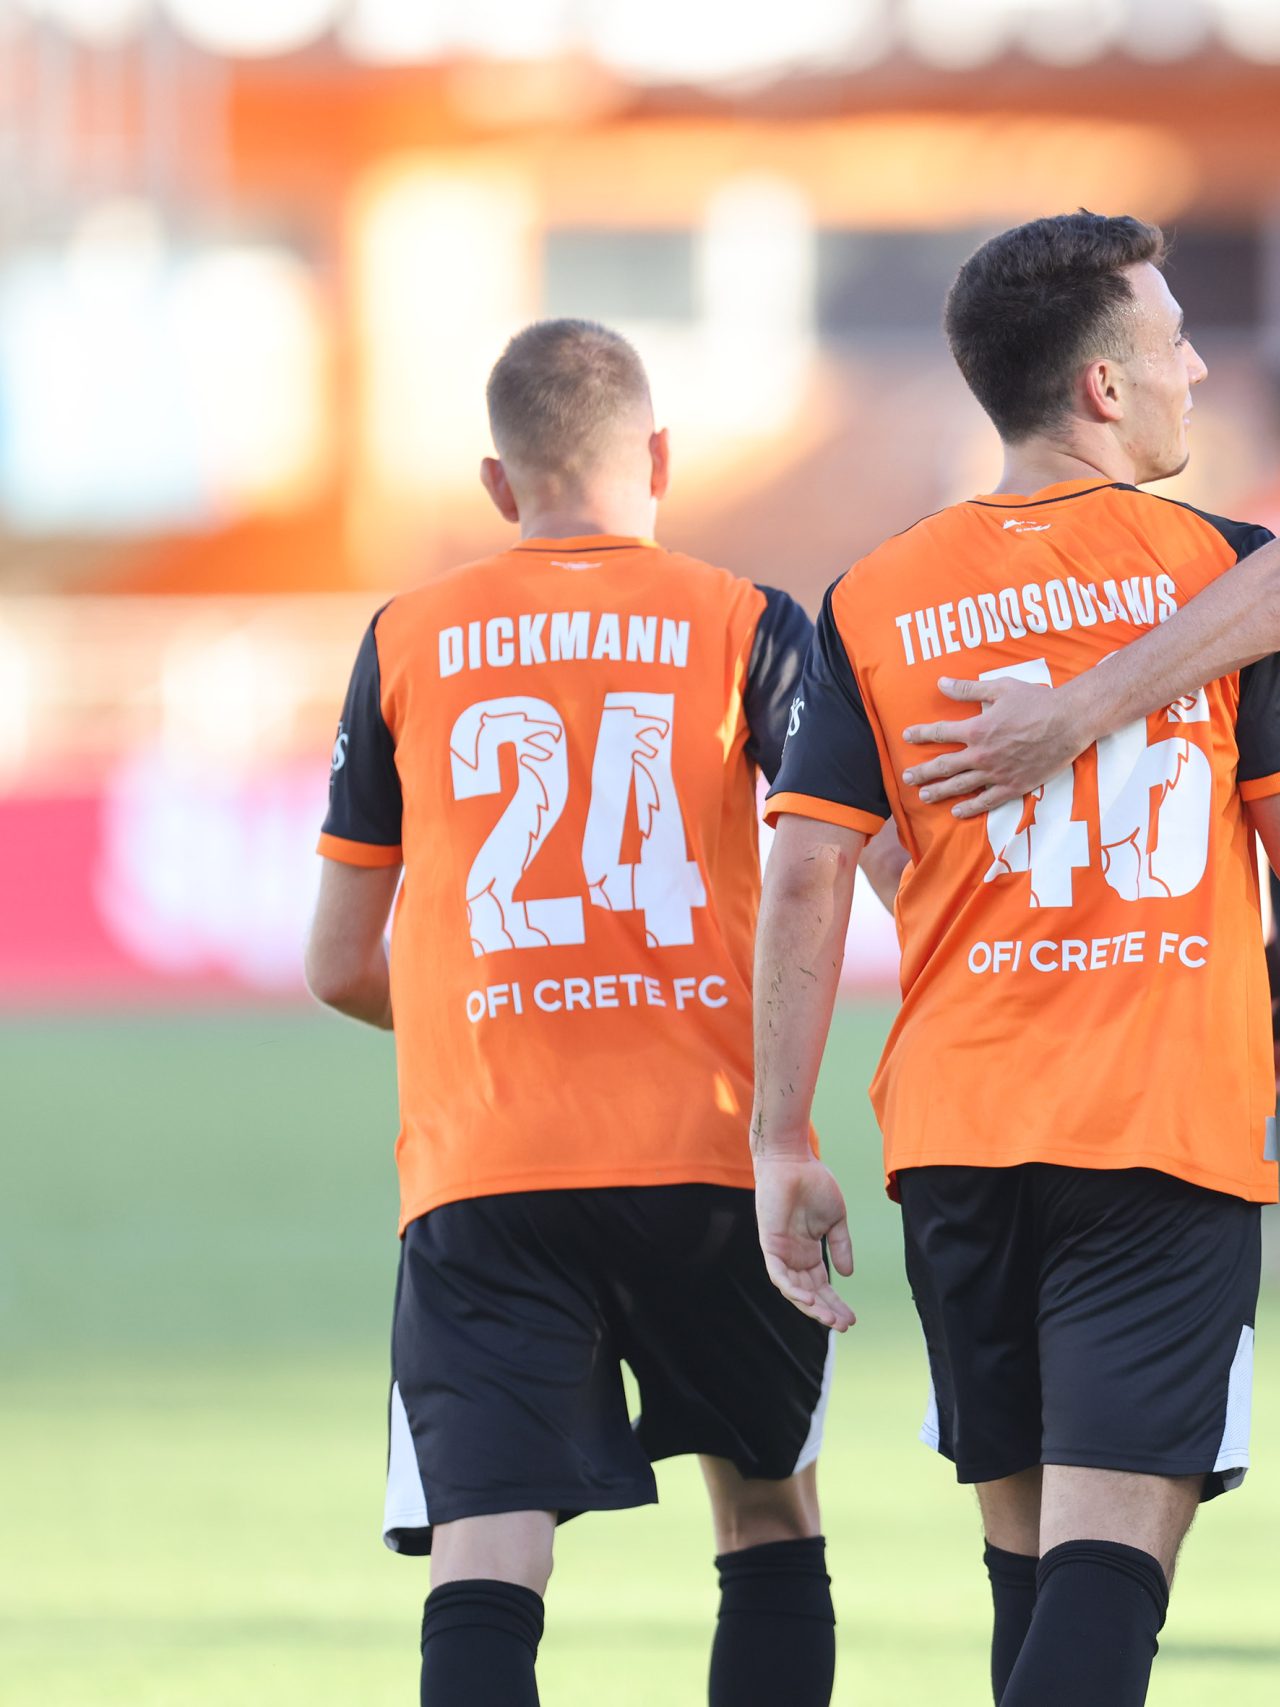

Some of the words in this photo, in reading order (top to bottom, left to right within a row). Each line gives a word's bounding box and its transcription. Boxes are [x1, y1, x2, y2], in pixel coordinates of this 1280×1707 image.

[438, 611, 691, 679] DICKMANN
[895, 574, 1178, 666] THEODOSOULAKIS
[979, 650, 1212, 908] 46
[449, 691, 707, 958] 24
[966, 938, 1022, 974] OFI
[1028, 931, 1145, 973] CRETE
[1157, 930, 1209, 969] FC
[466, 983, 521, 1024] OFI
[532, 973, 667, 1013] CRETE
[674, 974, 729, 1011] FC
